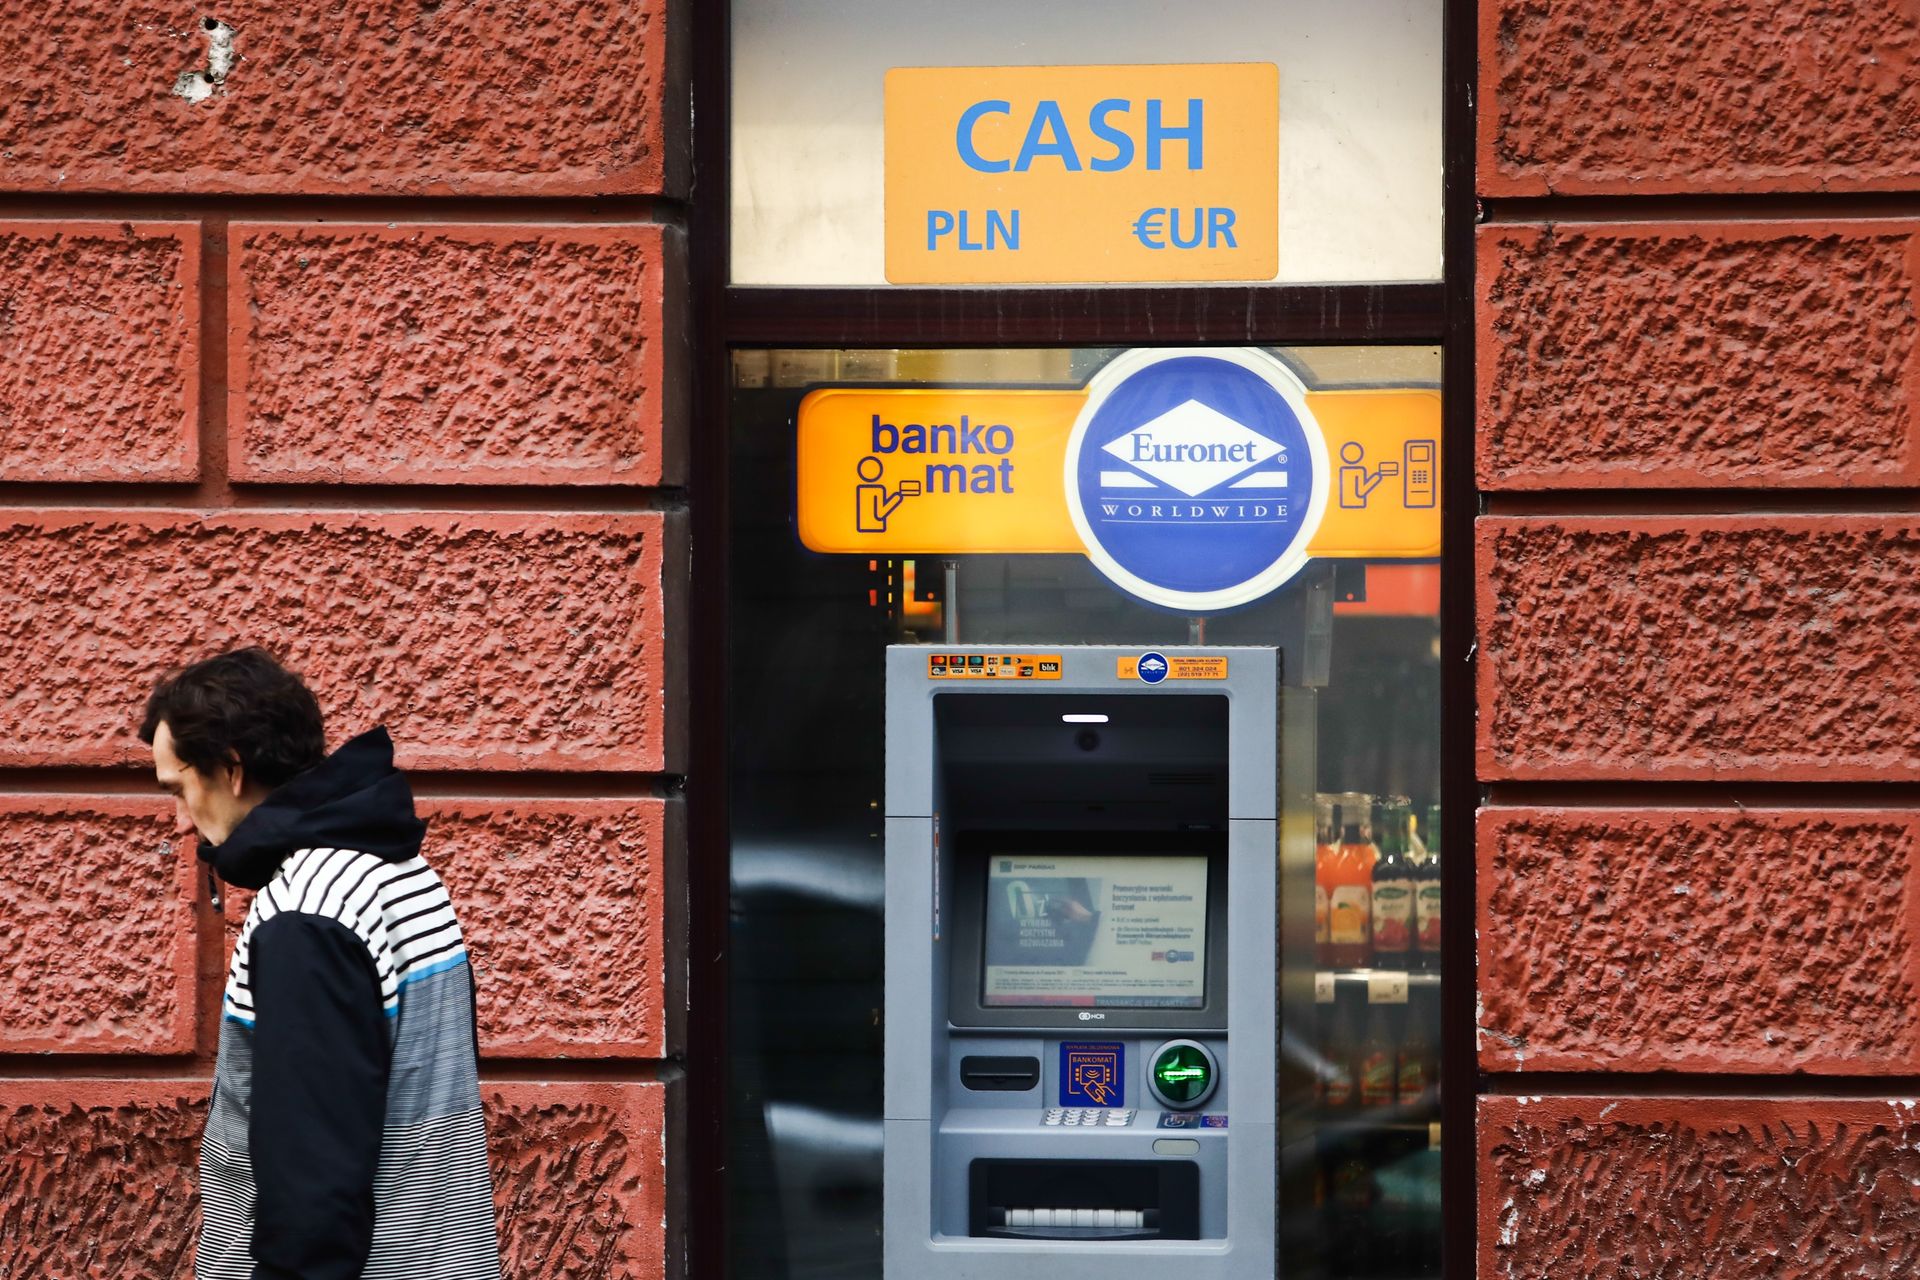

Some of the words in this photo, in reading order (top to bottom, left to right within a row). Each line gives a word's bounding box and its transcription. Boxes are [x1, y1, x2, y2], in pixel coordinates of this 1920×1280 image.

[955, 98, 1205, 174] CASH
[926, 209, 1020, 251] PLN
[1132, 206, 1239, 250] €UR
[872, 414, 1015, 457] banko
[1130, 432, 1258, 465] Euronet
[925, 458, 1015, 495] mat
[1101, 503, 1289, 519] WORLDWIDE
